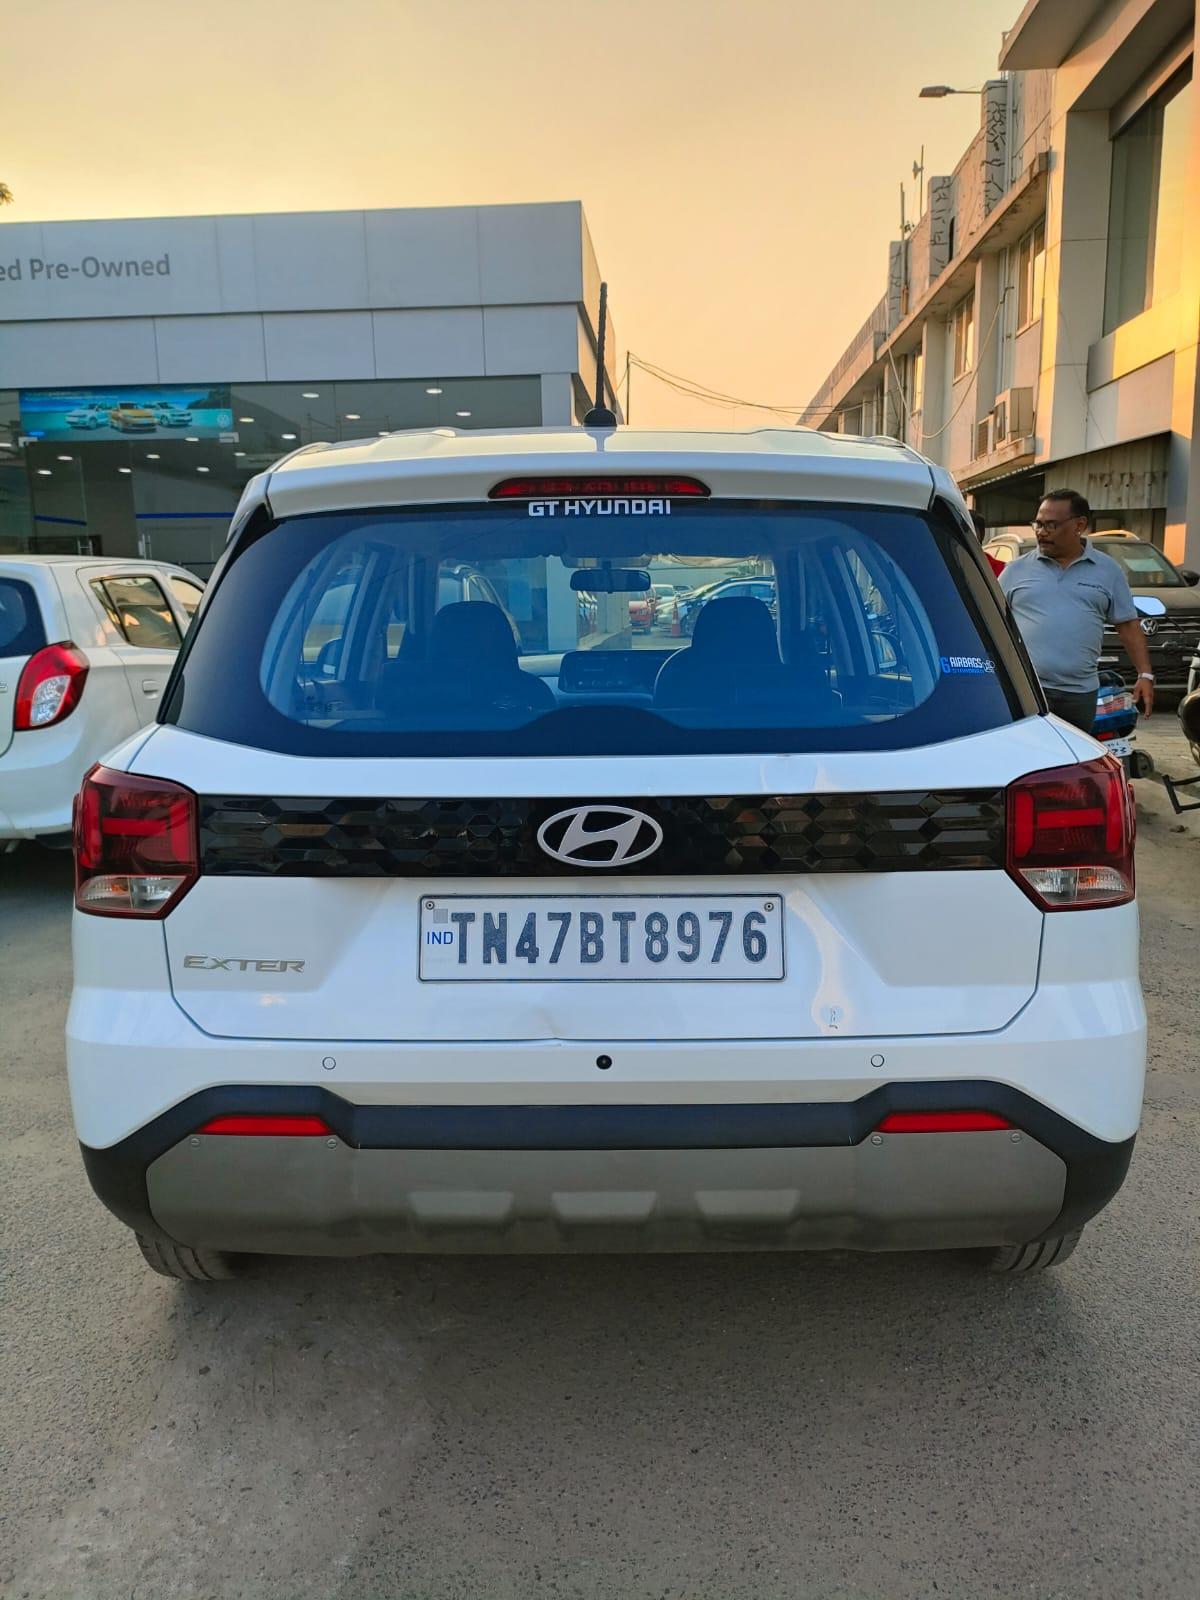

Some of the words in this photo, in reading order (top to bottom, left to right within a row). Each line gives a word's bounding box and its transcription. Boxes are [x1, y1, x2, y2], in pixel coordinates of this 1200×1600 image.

[29, 253, 171, 281] Pre-Owned
[528, 501, 559, 516] GT
[564, 499, 671, 516] HYUNDAI
[950, 656, 983, 668] AIRBAGS
[426, 931, 454, 945] IND
[450, 911, 767, 964] TN47BT8976
[183, 955, 305, 972] EXTER
